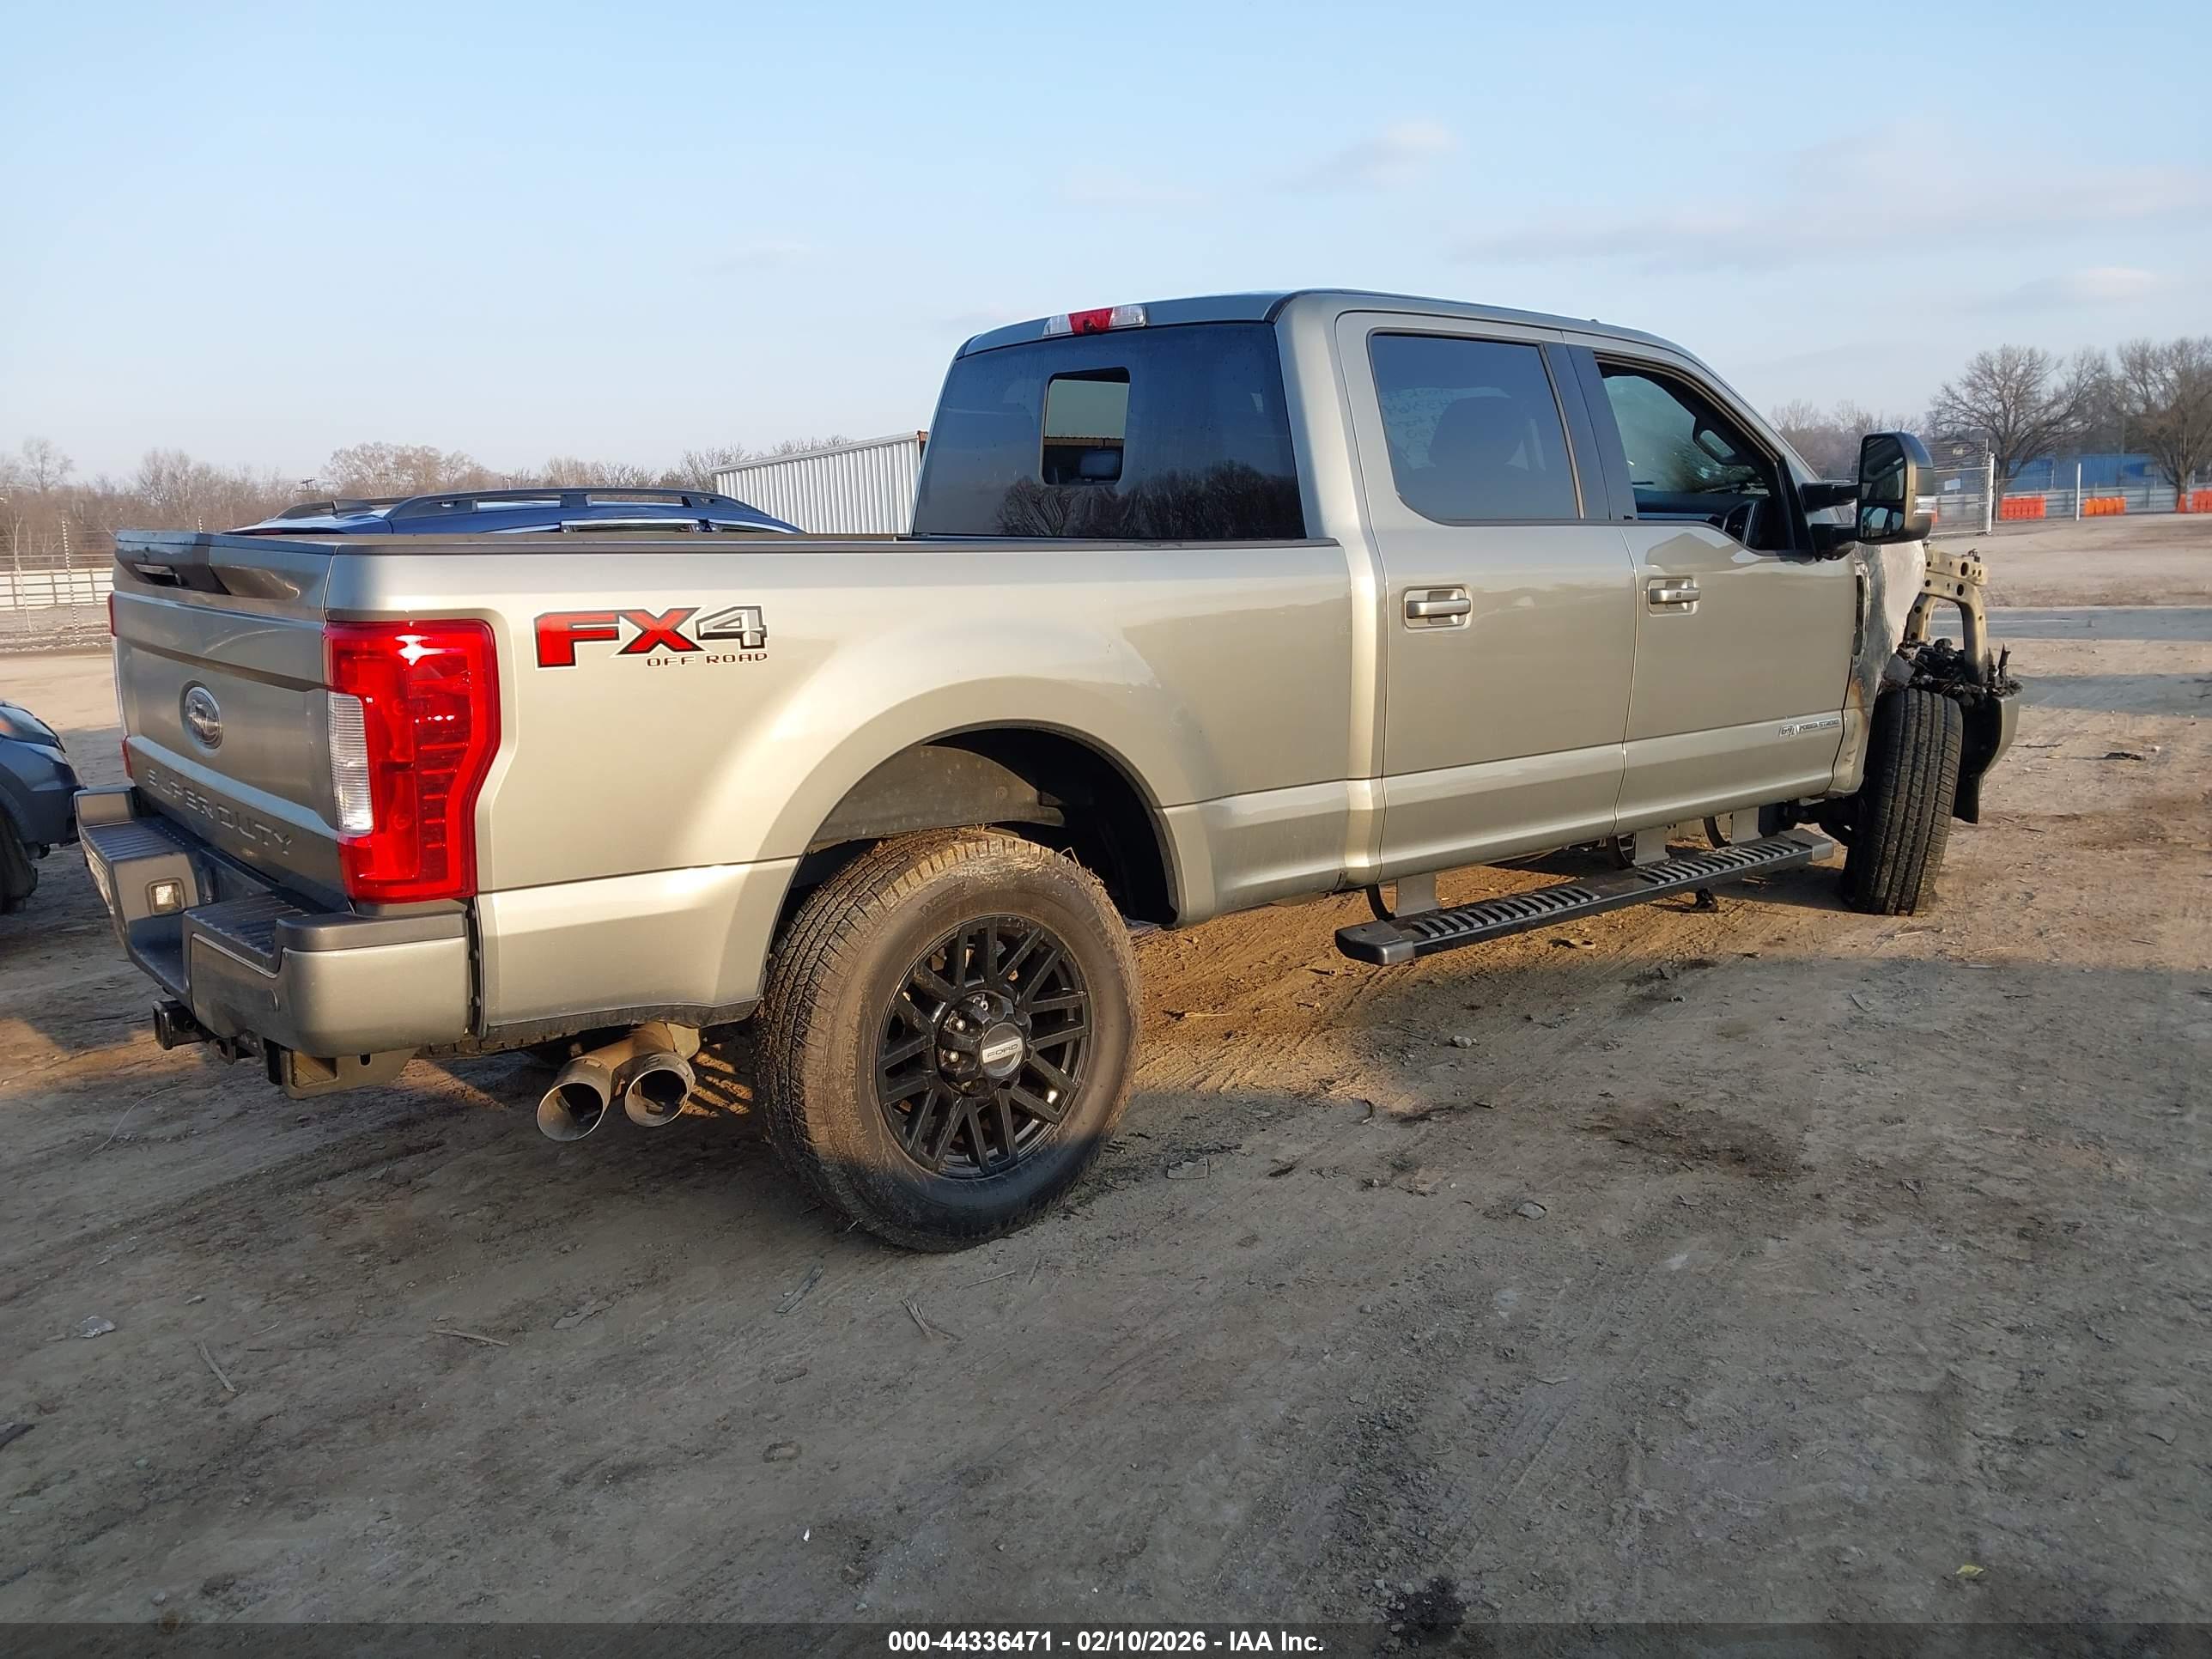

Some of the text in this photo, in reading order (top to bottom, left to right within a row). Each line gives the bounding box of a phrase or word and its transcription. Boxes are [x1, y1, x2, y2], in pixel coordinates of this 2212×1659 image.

[533, 605, 768, 668] FX4
[646, 653, 769, 668] OFF ROAD
[147, 767, 293, 856] SUPER DUTY
[987, 1043, 1019, 1058] FORD
